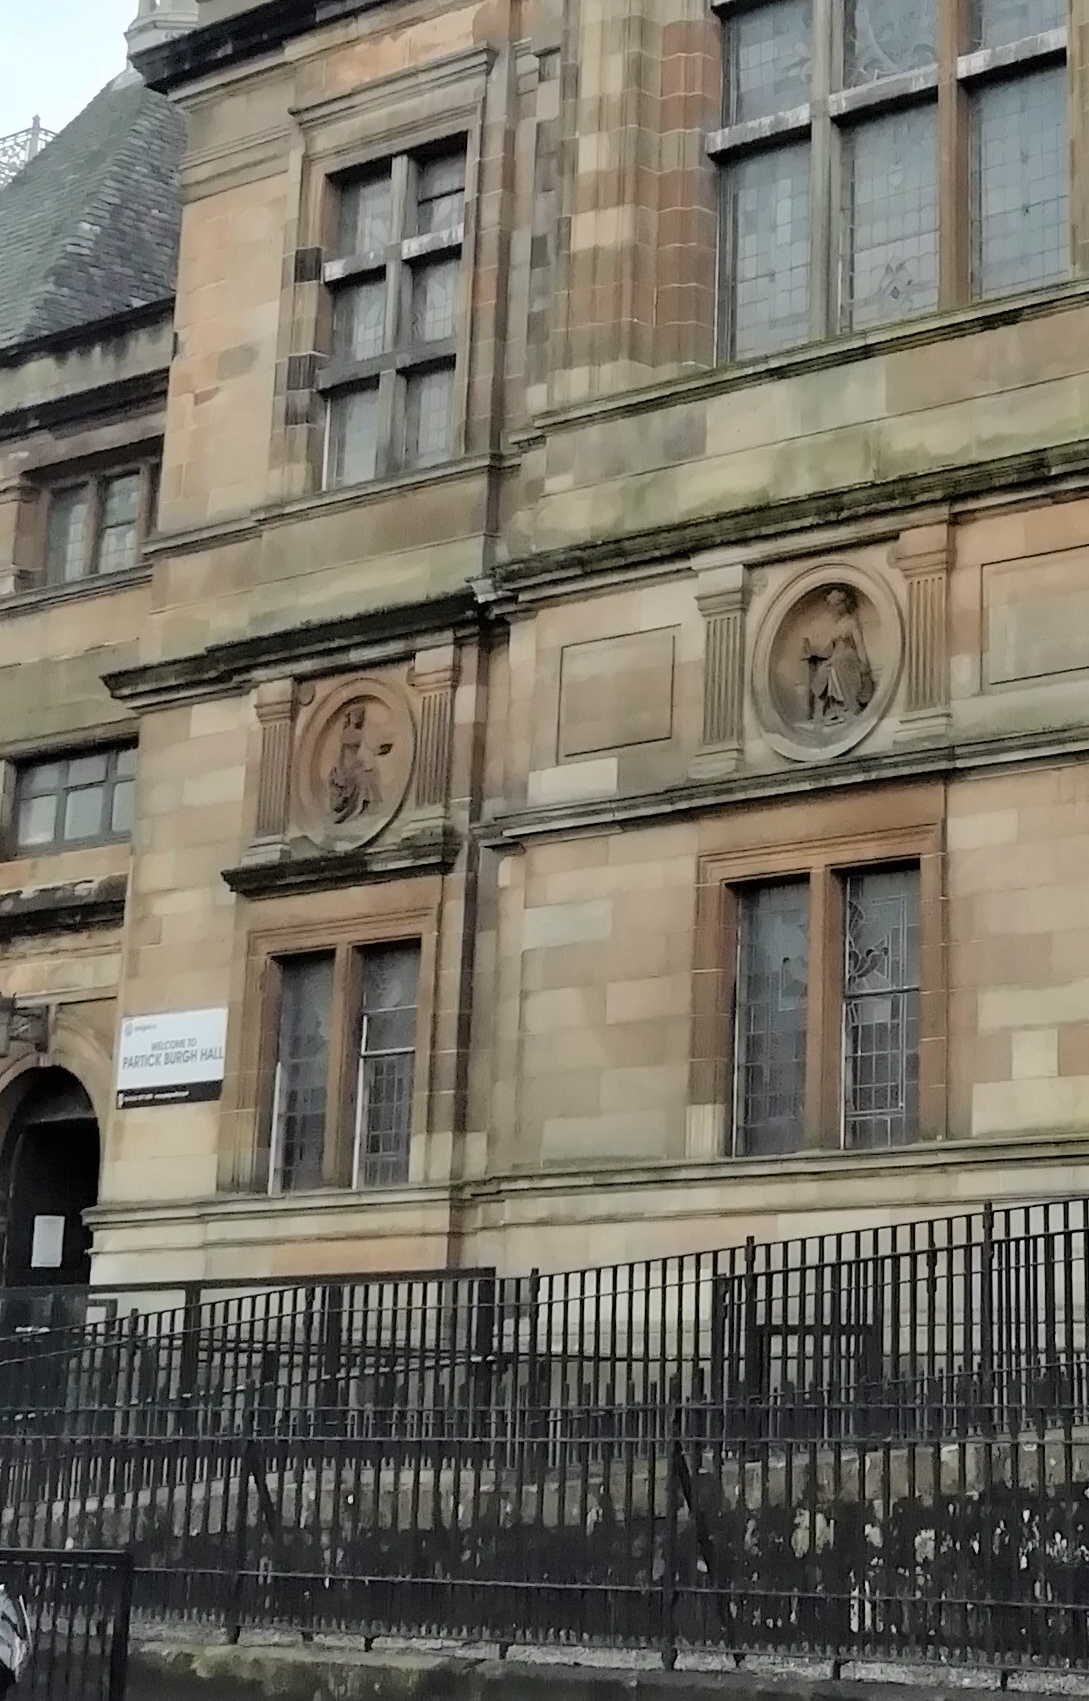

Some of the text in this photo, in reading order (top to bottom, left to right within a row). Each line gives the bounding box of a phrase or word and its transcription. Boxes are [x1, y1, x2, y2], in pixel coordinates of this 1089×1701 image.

[151, 1039, 186, 1051] WELCOME
[122, 1047, 224, 1070] PARTICK BURGH HALL
